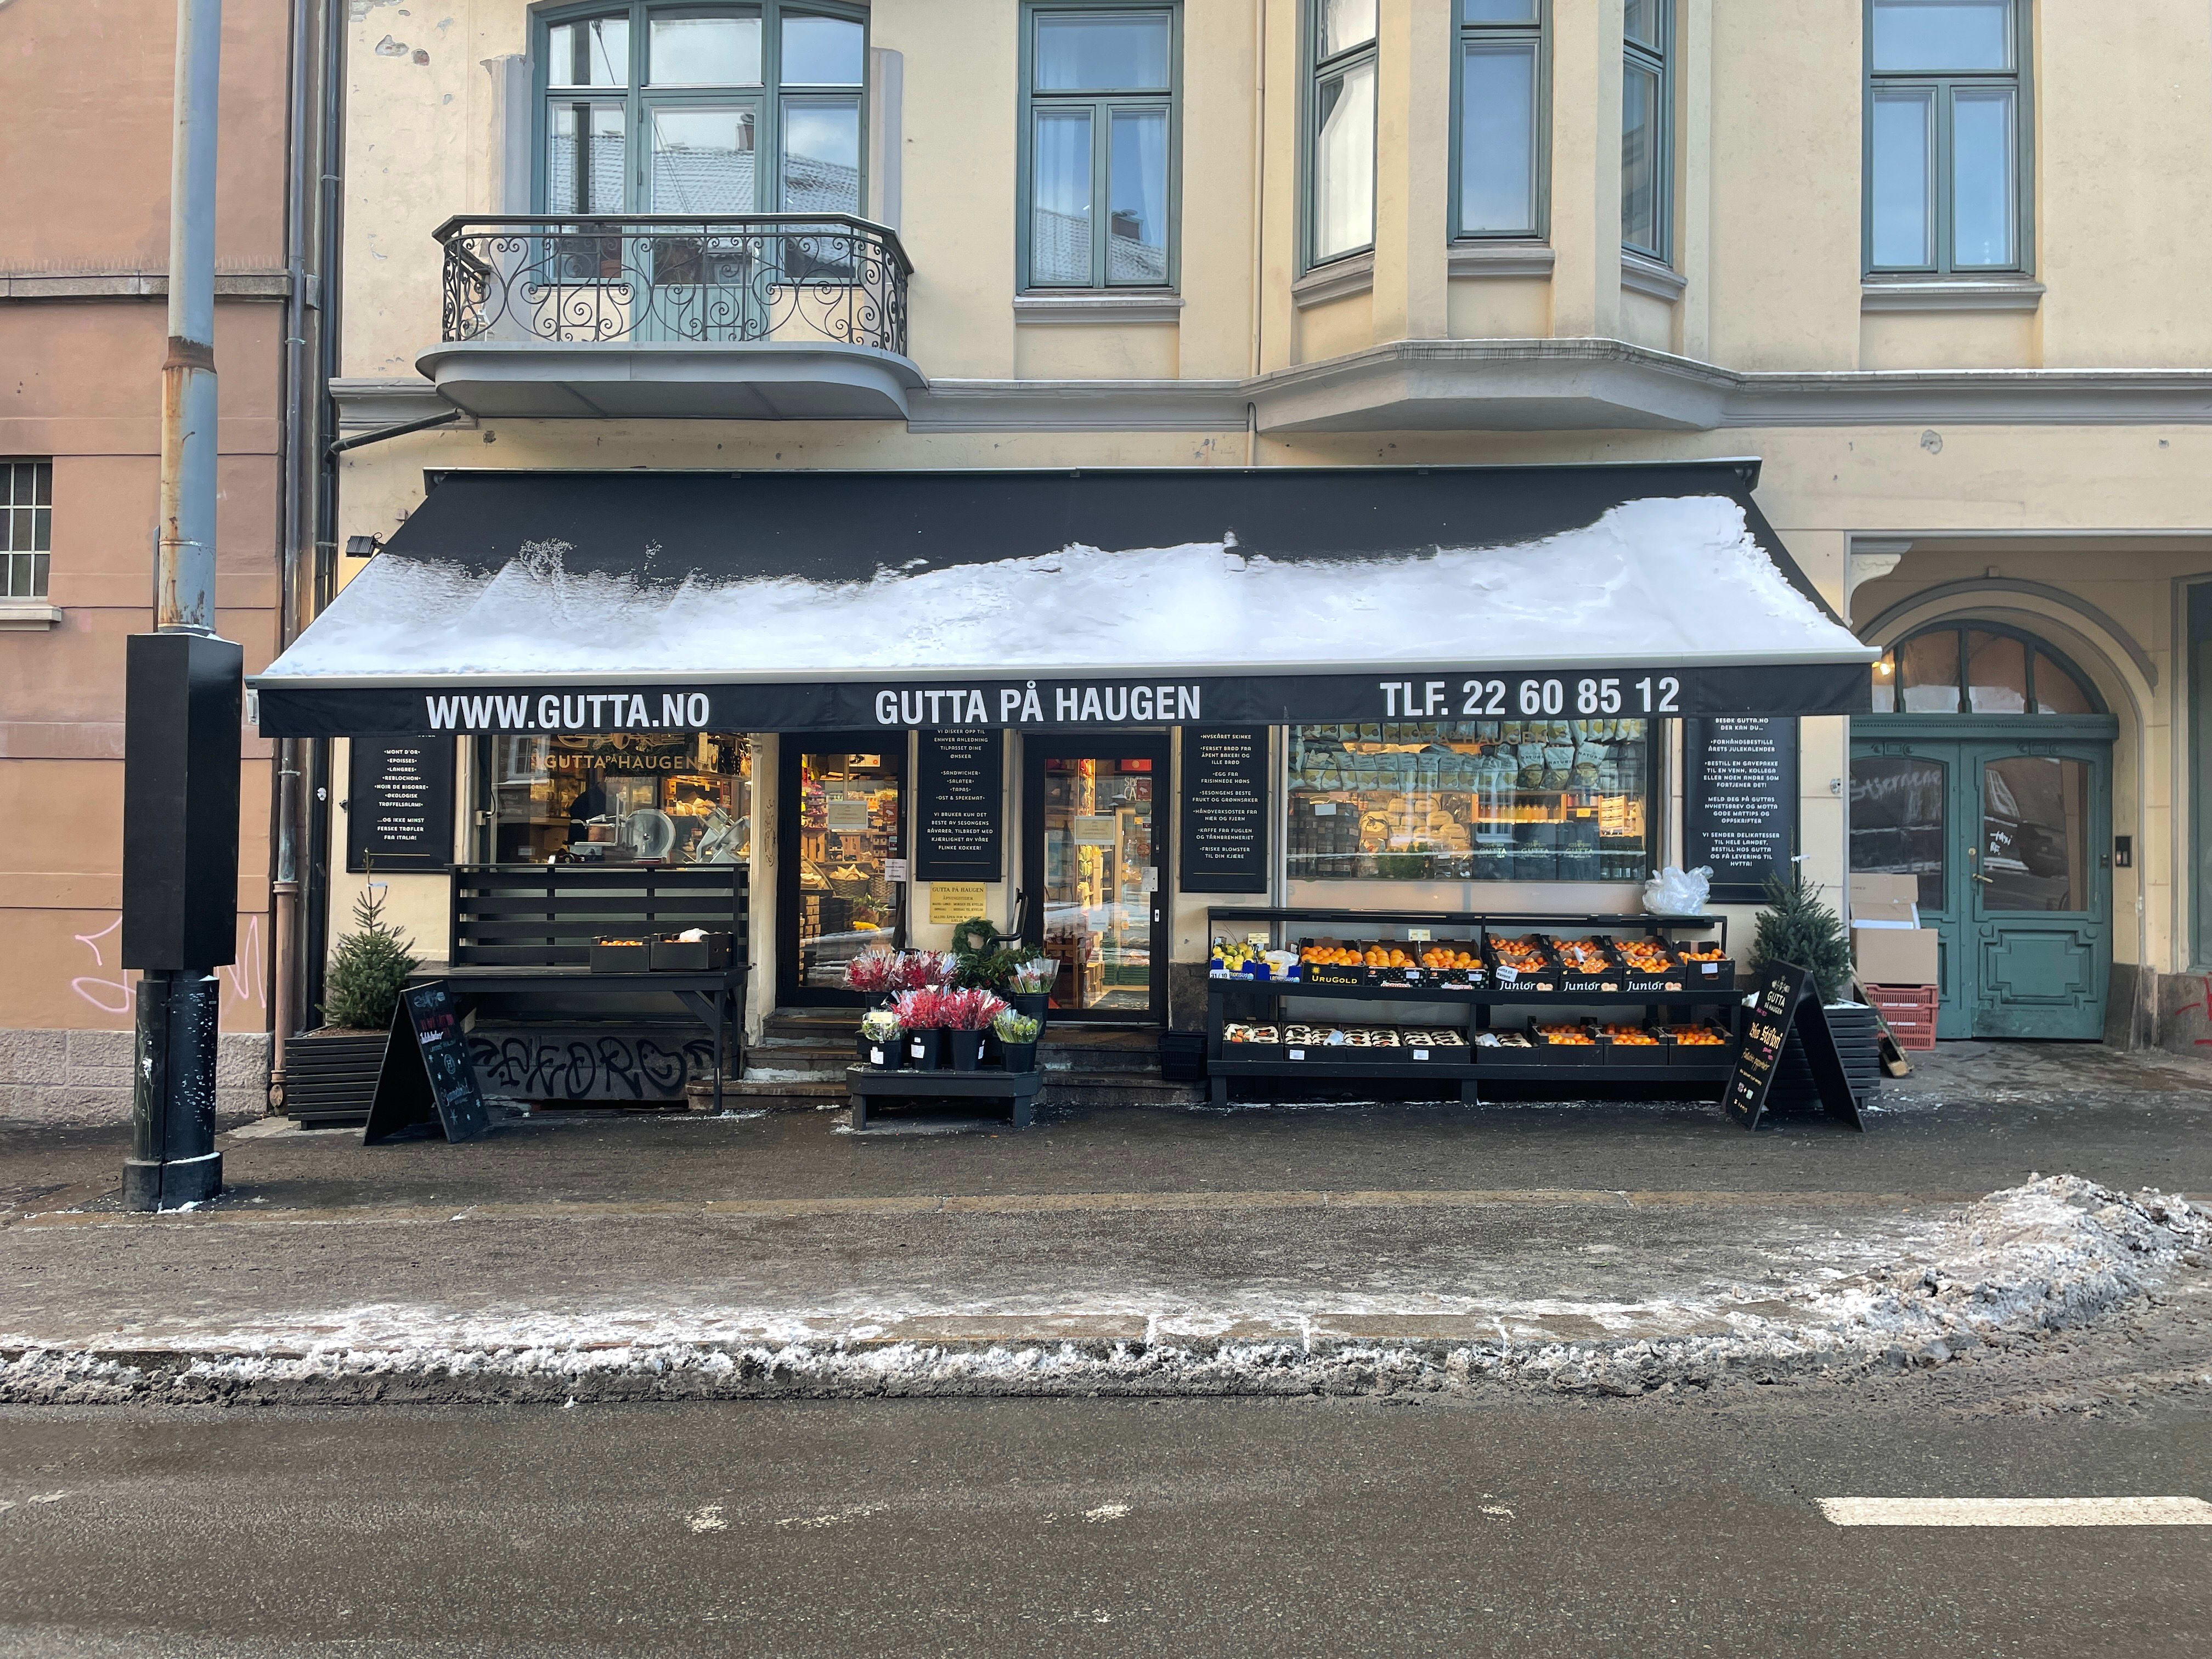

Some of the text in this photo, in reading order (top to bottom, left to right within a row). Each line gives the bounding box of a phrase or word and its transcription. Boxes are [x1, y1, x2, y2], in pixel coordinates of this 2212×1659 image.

[876, 680, 1199, 724] GUTTA PÅ HAUGEN
[1380, 676, 1679, 716] TLF. 22 60 85 12
[426, 693, 709, 729] WWW.GUTTA.NO
[544, 752, 697, 769] GUTTA PÅ HAUGEN
[1499, 980, 1536, 990] Junior
[1564, 981, 1599, 992] Junior
[1626, 981, 1663, 992] Junior
[1767, 991, 1785, 1007] GUTTA
